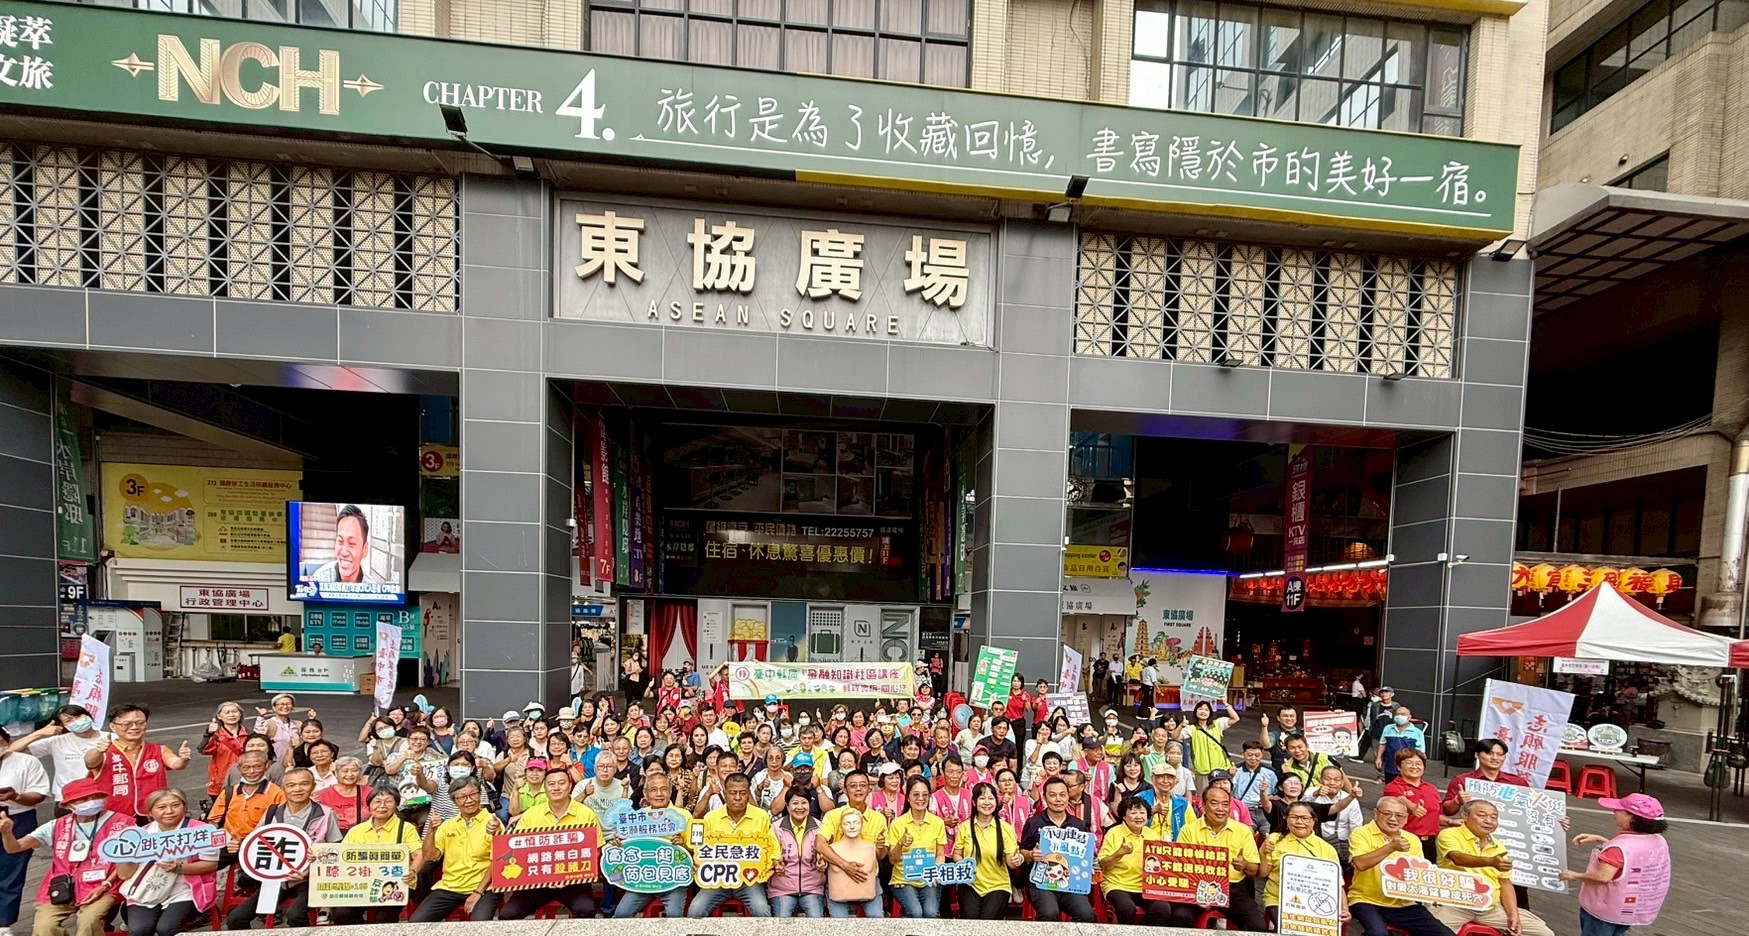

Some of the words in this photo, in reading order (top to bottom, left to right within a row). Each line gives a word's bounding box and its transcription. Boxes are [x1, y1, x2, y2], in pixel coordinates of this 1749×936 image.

[158, 34, 340, 116] NCH
[422, 80, 543, 114] CHAPTER
[555, 67, 615, 142] 4.
[574, 210, 971, 309] 東協廣場
[647, 298, 750, 326] ASEAN
[779, 308, 900, 335] SQUARE
[126, 478, 145, 496] 3F
[1291, 479, 1306, 523] 銀櫃
[801, 526, 875, 539] TEL:22255757
[1288, 523, 1306, 539] KTV
[599, 558, 611, 575] 7F
[67, 585, 84, 599] 9F
[198, 589, 251, 598] 東協廣場
[1286, 593, 1301, 607] 11F
[185, 597, 264, 608] 行政管理中心
[1162, 609, 1194, 621] 東協廣場
[753, 668, 799, 681] 臺中郵局
[618, 811, 647, 825] 臺中市
[113, 830, 210, 856] 心跳不打烊
[254, 836, 300, 871] 詐
[526, 847, 592, 864] 網路無白馬
[698, 845, 760, 860] 全民急救
[625, 866, 690, 882] 荷包見底
[700, 864, 738, 883] CPR
[906, 865, 972, 883] 一手相救
